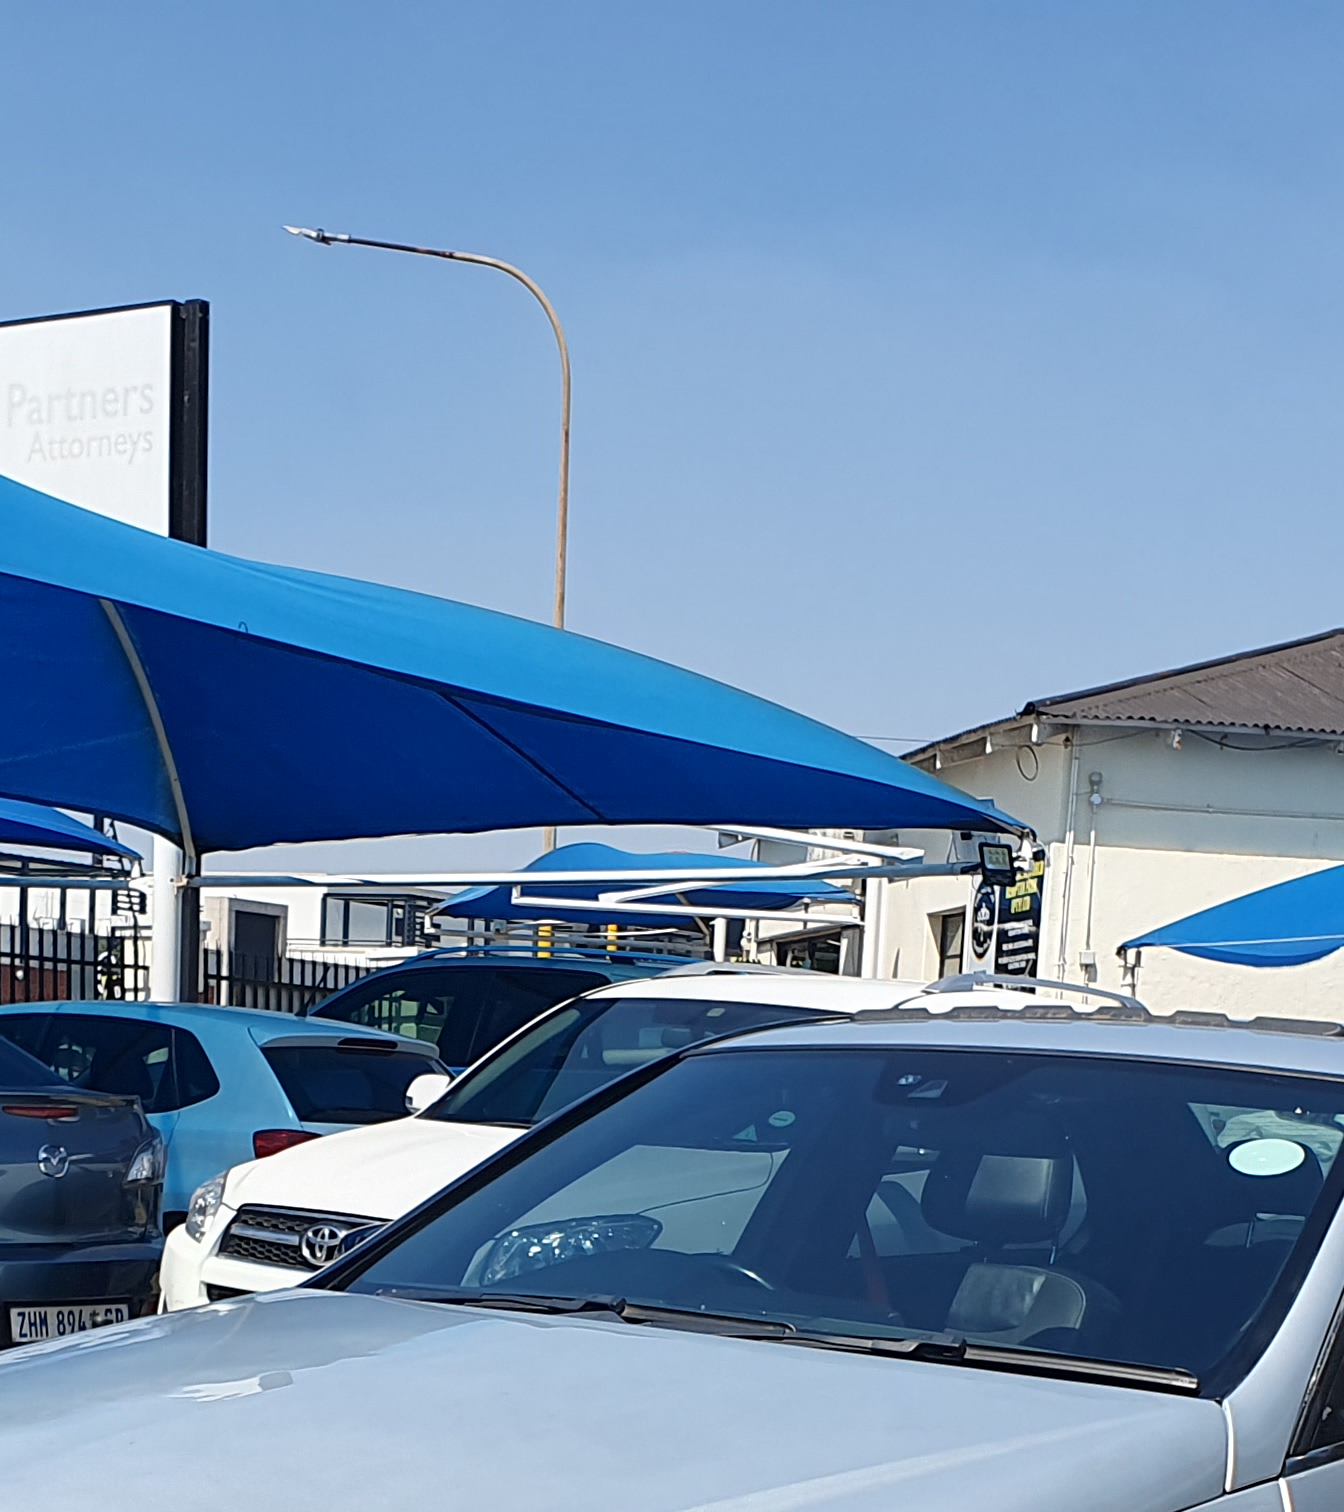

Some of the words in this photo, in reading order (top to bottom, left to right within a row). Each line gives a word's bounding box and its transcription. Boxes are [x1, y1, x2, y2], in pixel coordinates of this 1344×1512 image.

[7, 382, 155, 430] Partners
[27, 427, 154, 465] Attorneys
[17, 1310, 50, 1338] ZHM
[56, 1308, 87, 1336] 894
